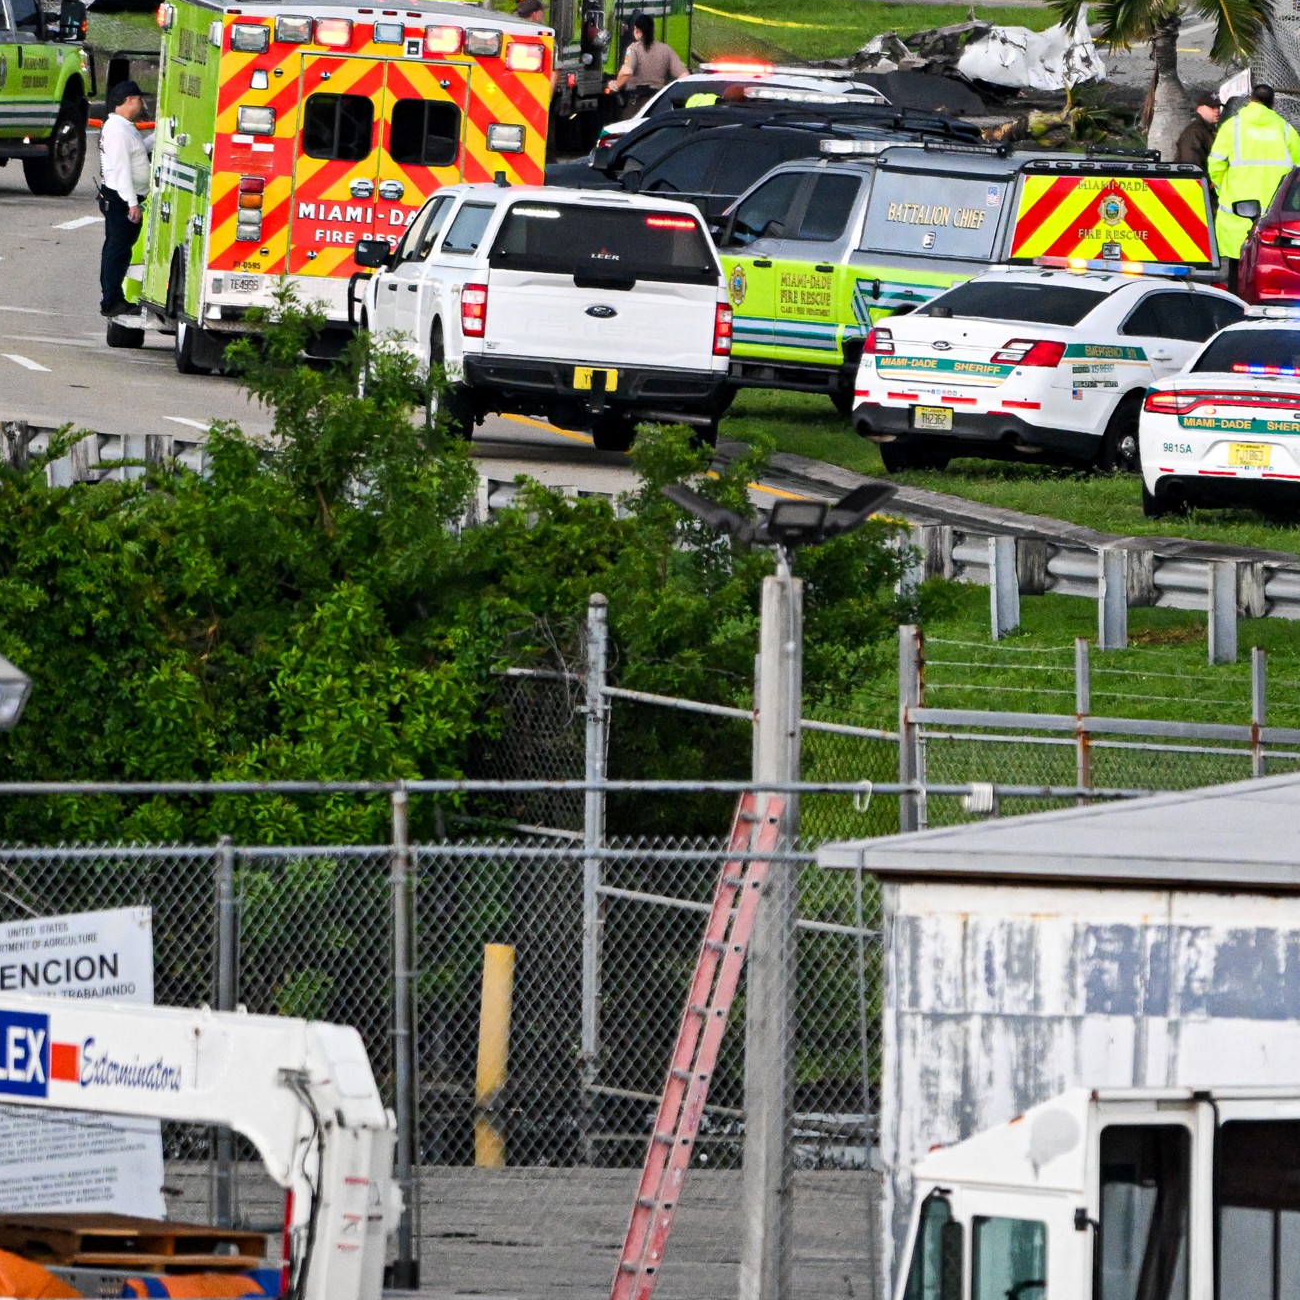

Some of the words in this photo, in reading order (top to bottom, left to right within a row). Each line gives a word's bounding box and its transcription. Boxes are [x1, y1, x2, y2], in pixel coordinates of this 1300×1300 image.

[1079, 180, 1150, 192] MIAMI-DADE
[886, 202, 951, 227] BATTALION
[953, 208, 987, 230] CHIEF
[315, 229, 355, 245] FIRE
[1078, 229, 1102, 240] FIRE
[1105, 229, 1149, 241] RESCUE
[591, 253, 620, 261] LEER
[781, 272, 831, 290] MIAMI-DADE
[780, 289, 799, 304] FIRE
[800, 292, 831, 307] RESCUE
[880, 357, 939, 369] MIAMI-DADE
[954, 362, 1001, 375] SHERIFF
[1183, 417, 1252, 430] MIAMI-DADE
[1163, 442, 1193, 454] 9815A
[8, 926, 36, 939] UNITED
[39, 922, 69, 935] STATES
[31, 939, 41, 950] OF
[43, 932, 98, 949] AGRICULTURE
[80, 1036, 183, 1093] Exterminators
